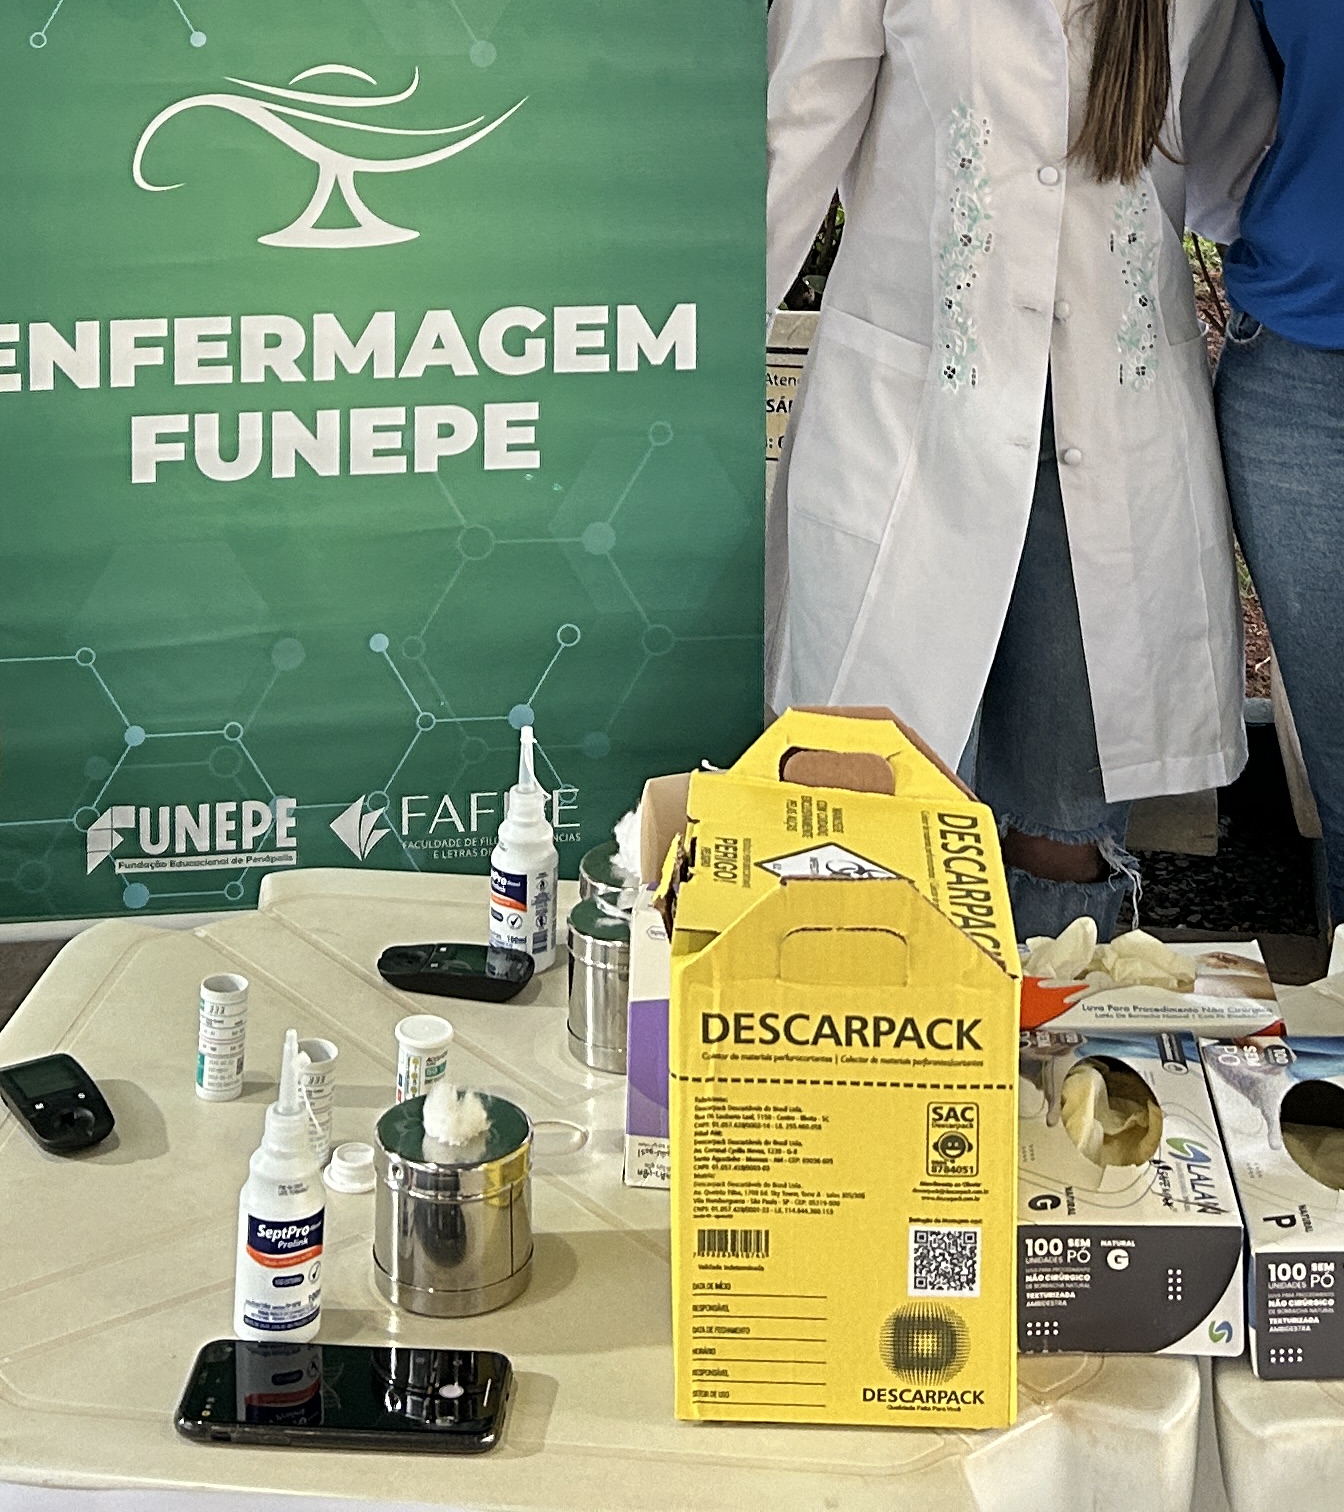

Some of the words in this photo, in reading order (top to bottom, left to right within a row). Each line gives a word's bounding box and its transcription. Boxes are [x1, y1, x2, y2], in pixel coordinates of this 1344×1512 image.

[130, 402, 541, 484] FUNEPE
[401, 789, 581, 835] FAFE
[403, 840, 461, 849] FACULDADE
[465, 839, 477, 847] DE
[119, 860, 168, 870] Fundação
[170, 857, 230, 868] Educacional
[246, 854, 293, 866] Penápolis
[434, 850, 439, 859] E
[442, 849, 478, 859] LETRAS
[714, 838, 738, 884] PERIGO!
[937, 813, 1002, 957] DESCARPAC
[1082, 1004, 1104, 1012] Luva
[702, 1012, 983, 1050] DESCARPACK
[932, 1106, 974, 1122] SAC
[1028, 1194, 1061, 1211] G
[1263, 1214, 1296, 1229] P
[257, 1224, 310, 1242] SeptPro
[277, 1237, 308, 1249] Prolink
[1025, 1238, 1063, 1257] 100
[1067, 1238, 1091, 1247] SEM
[1067, 1247, 1091, 1263] PÓ
[1106, 1249, 1129, 1270] G
[1268, 1263, 1307, 1282] 100
[1311, 1263, 1335, 1272] SEM
[1025, 1273, 1044, 1282] NÃO
[1268, 1281, 1307, 1289] UNIDADES
[1311, 1271, 1335, 1288] PÓ
[1268, 1299, 1287, 1307] NÃO
[863, 1388, 985, 1405] DESCARPACK
